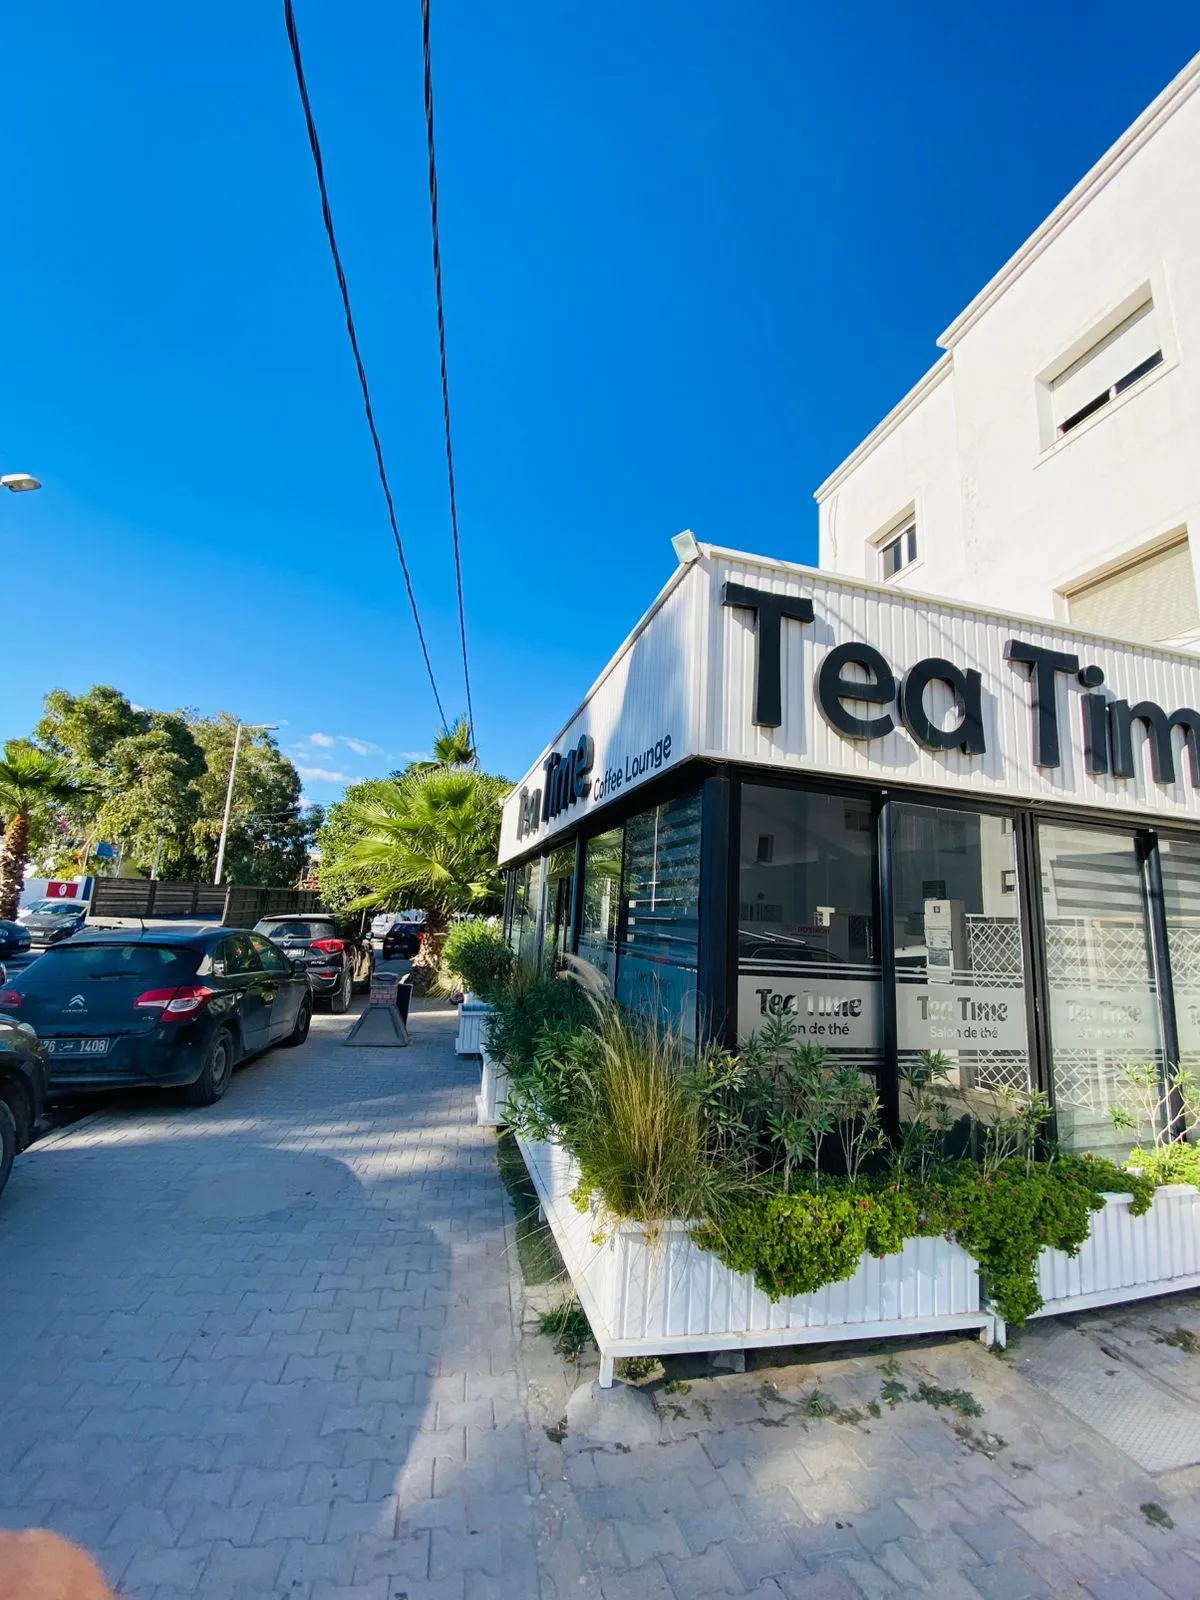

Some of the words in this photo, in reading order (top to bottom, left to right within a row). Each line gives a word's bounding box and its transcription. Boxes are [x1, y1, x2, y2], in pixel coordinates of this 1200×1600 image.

[722, 581, 986, 755] Tea
[593, 767, 622, 801] Coffee
[625, 734, 672, 784] Lounge
[755, 988, 798, 1016] Tea
[809, 1022, 826, 1035] de
[829, 1022, 850, 1036] thé
[930, 1025, 961, 1039] Salon
[964, 1026, 978, 1039] de
[980, 1026, 999, 1039] thé
[40, 1040, 56, 1053] 76
[80, 1039, 106, 1053] 1408
